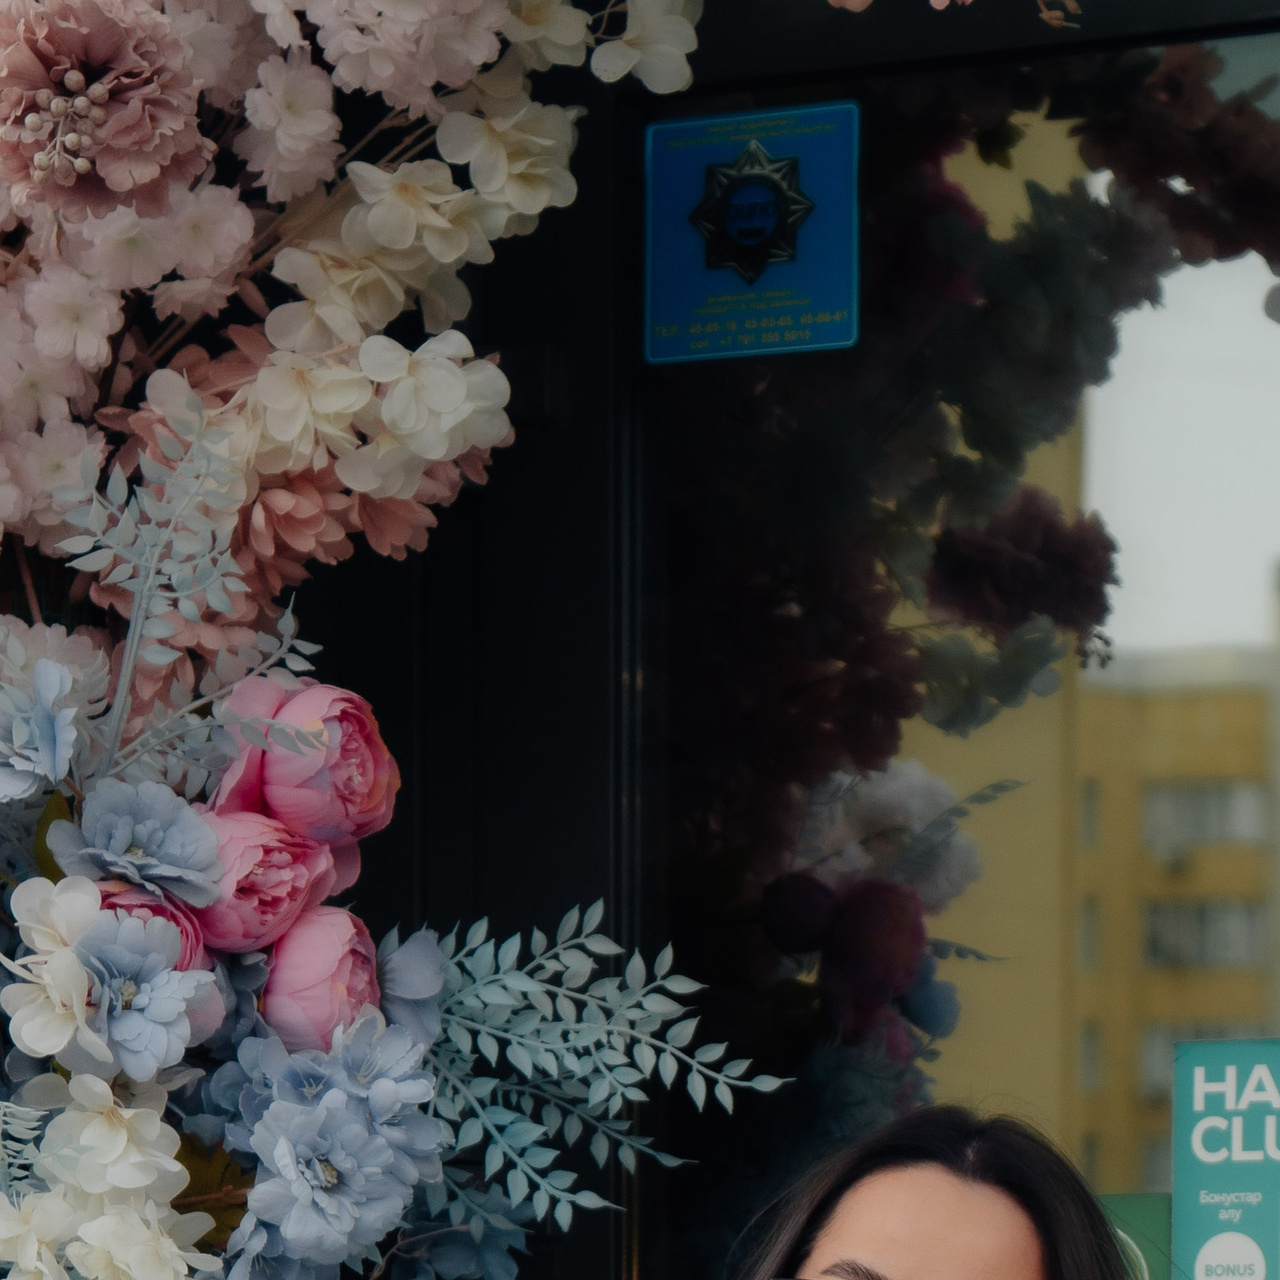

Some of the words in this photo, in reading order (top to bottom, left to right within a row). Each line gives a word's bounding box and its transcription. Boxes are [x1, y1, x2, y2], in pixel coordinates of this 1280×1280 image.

[1199, 1190, 1263, 1206] Бонустар
[1218, 1208, 1243, 1223] алу
[1204, 1263, 1256, 1279] BONUS
